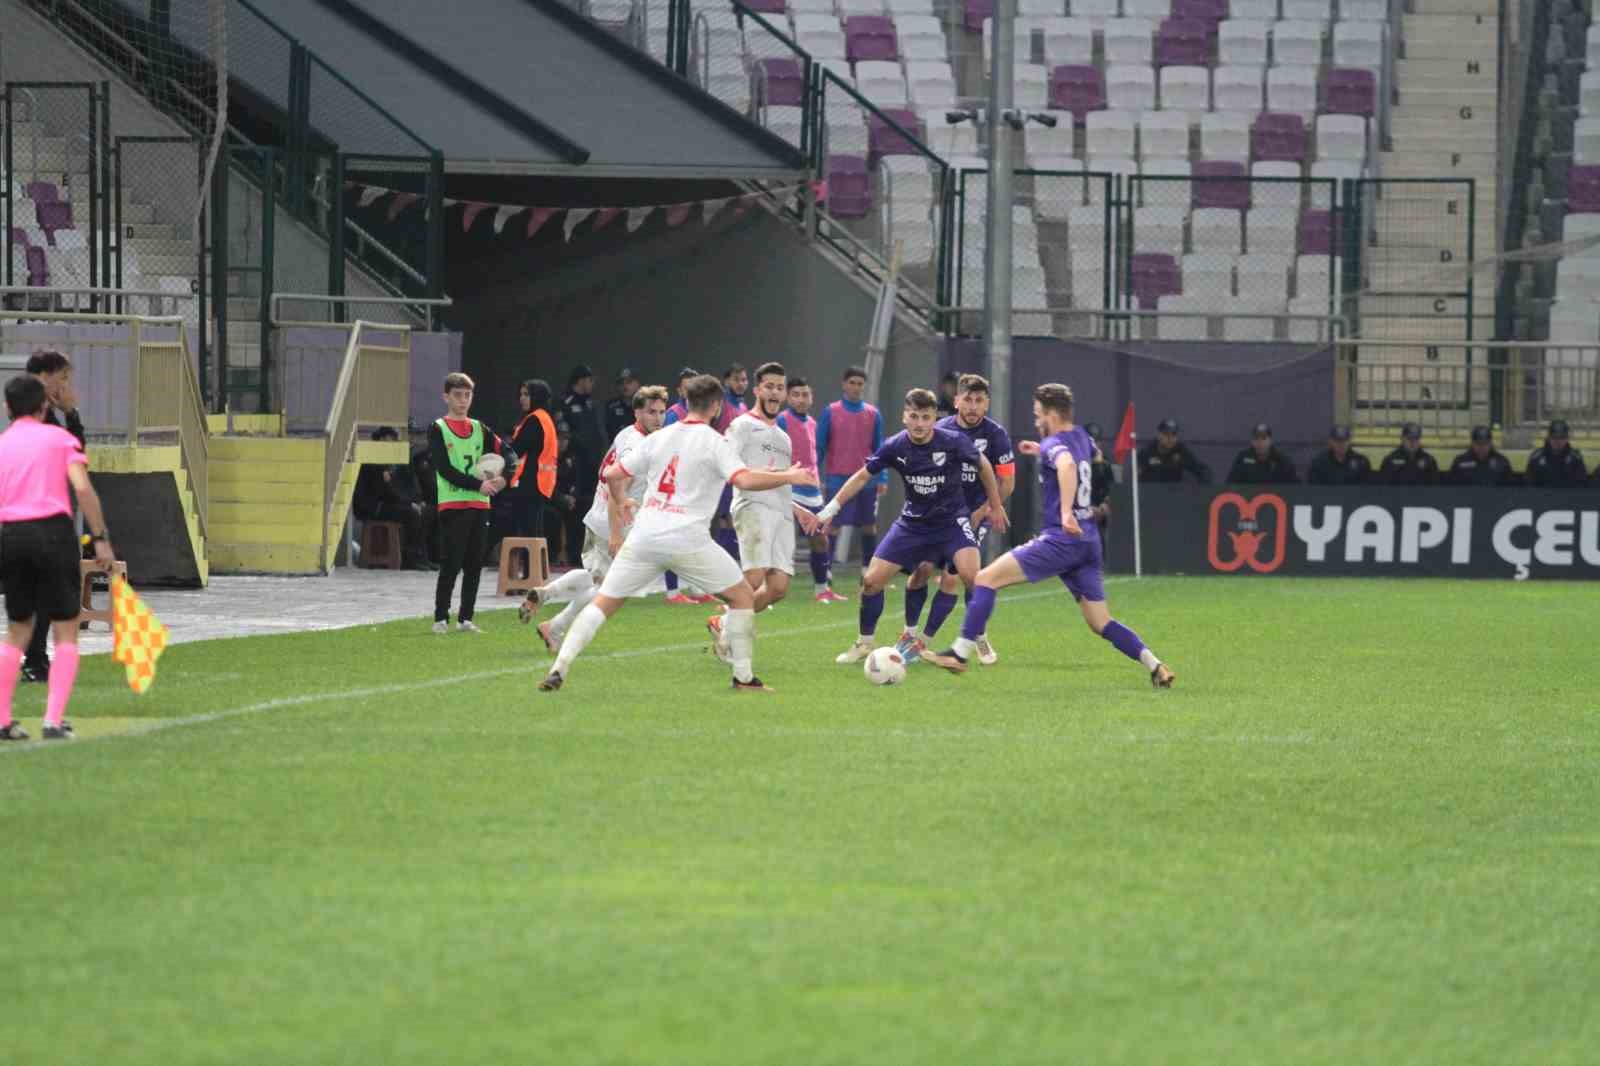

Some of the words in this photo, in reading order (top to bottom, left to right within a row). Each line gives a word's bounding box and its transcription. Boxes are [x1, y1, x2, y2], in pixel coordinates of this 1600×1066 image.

[1466, 61, 1480, 75] H
[1459, 106, 1473, 120] G
[1450, 153, 1461, 167] F
[1447, 200, 1457, 215] E
[126, 226, 135, 239] D
[1440, 250, 1453, 263] D
[1433, 298, 1447, 312] C
[1426, 346, 1438, 360] B
[1420, 386, 1431, 399] A
[657, 454, 680, 501] 4
[1293, 505, 1473, 565] YAPI
